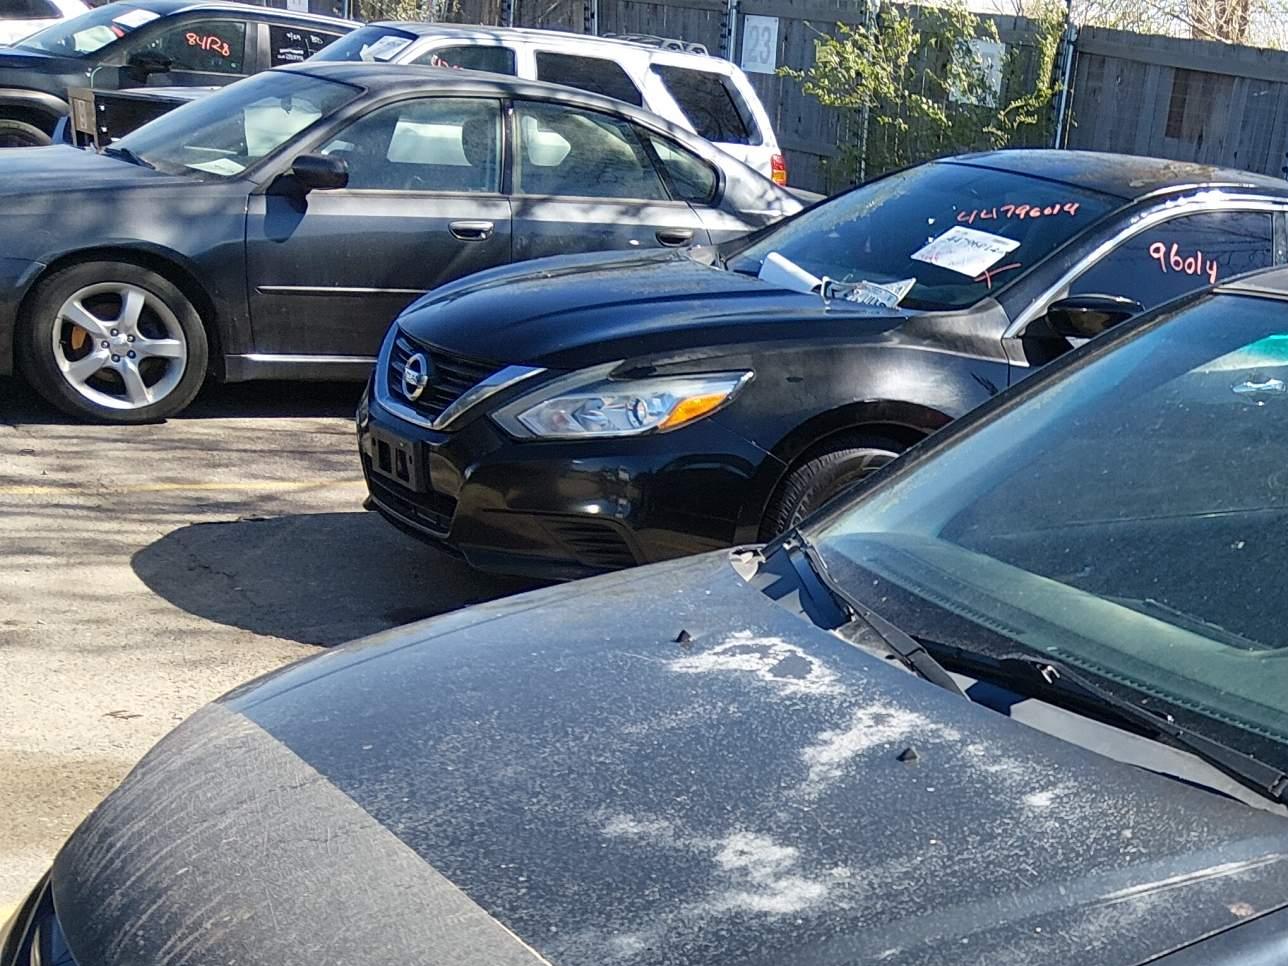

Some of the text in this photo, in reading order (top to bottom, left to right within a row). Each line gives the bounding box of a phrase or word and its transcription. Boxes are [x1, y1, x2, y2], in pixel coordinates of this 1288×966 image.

[746, 25, 771, 65] 23
[957, 202, 1080, 224] 44796014
[1149, 242, 1217, 285] 96014
